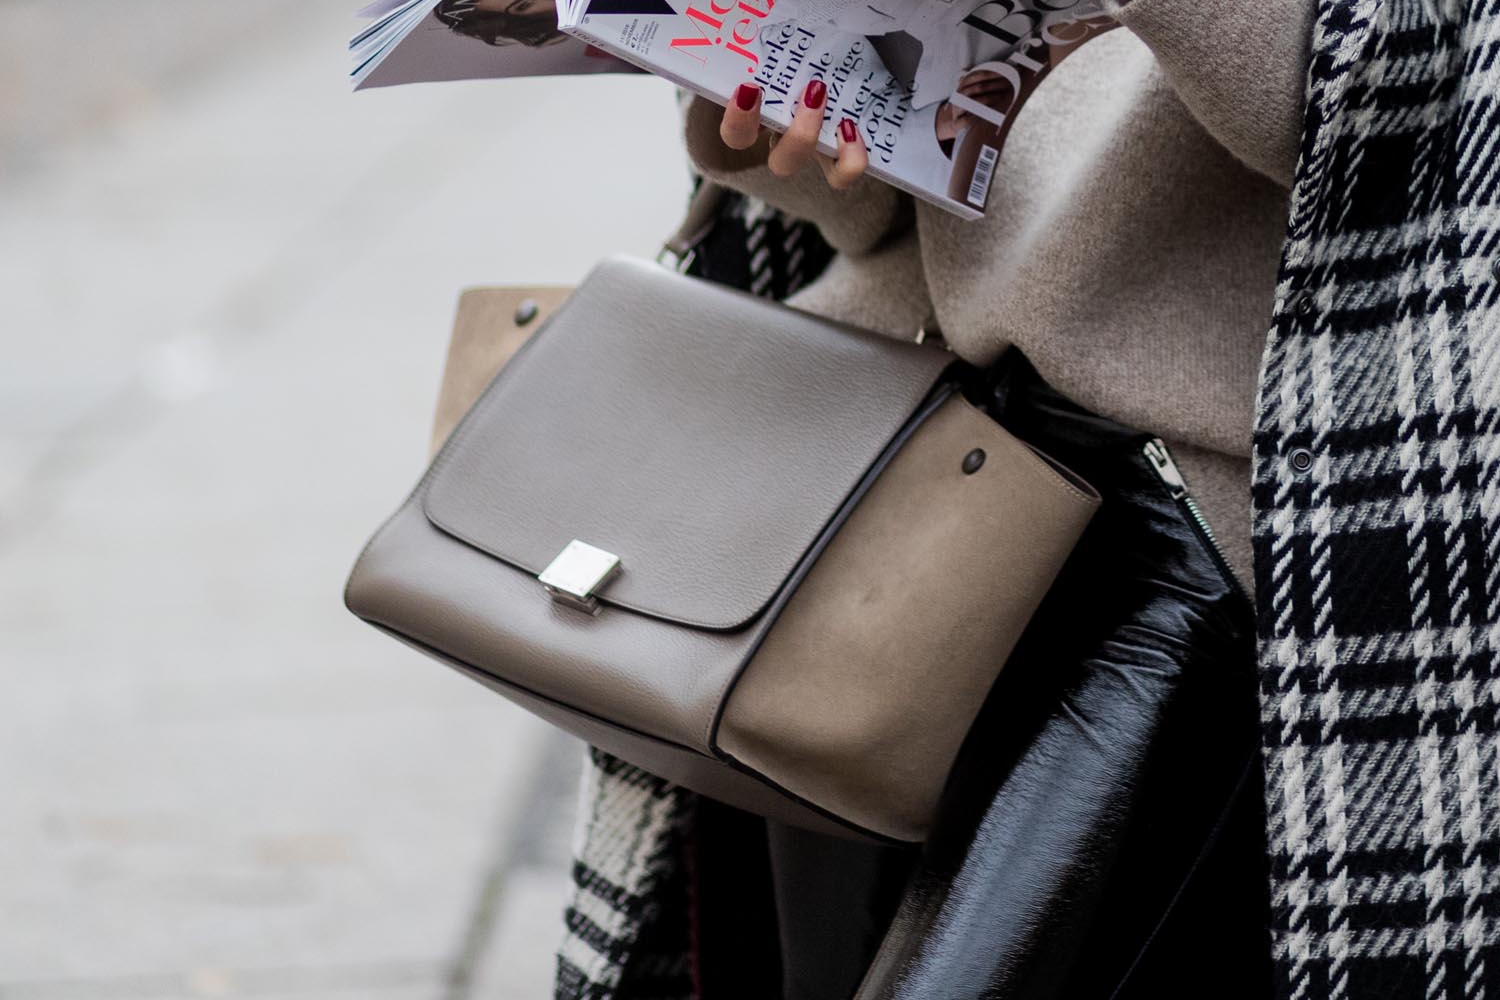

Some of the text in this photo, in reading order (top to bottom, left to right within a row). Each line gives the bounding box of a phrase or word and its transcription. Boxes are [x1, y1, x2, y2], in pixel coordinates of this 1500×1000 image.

[763, 27, 816, 112] Mäntel
[834, 71, 875, 138] ker-
[874, 79, 919, 163] de luxe
